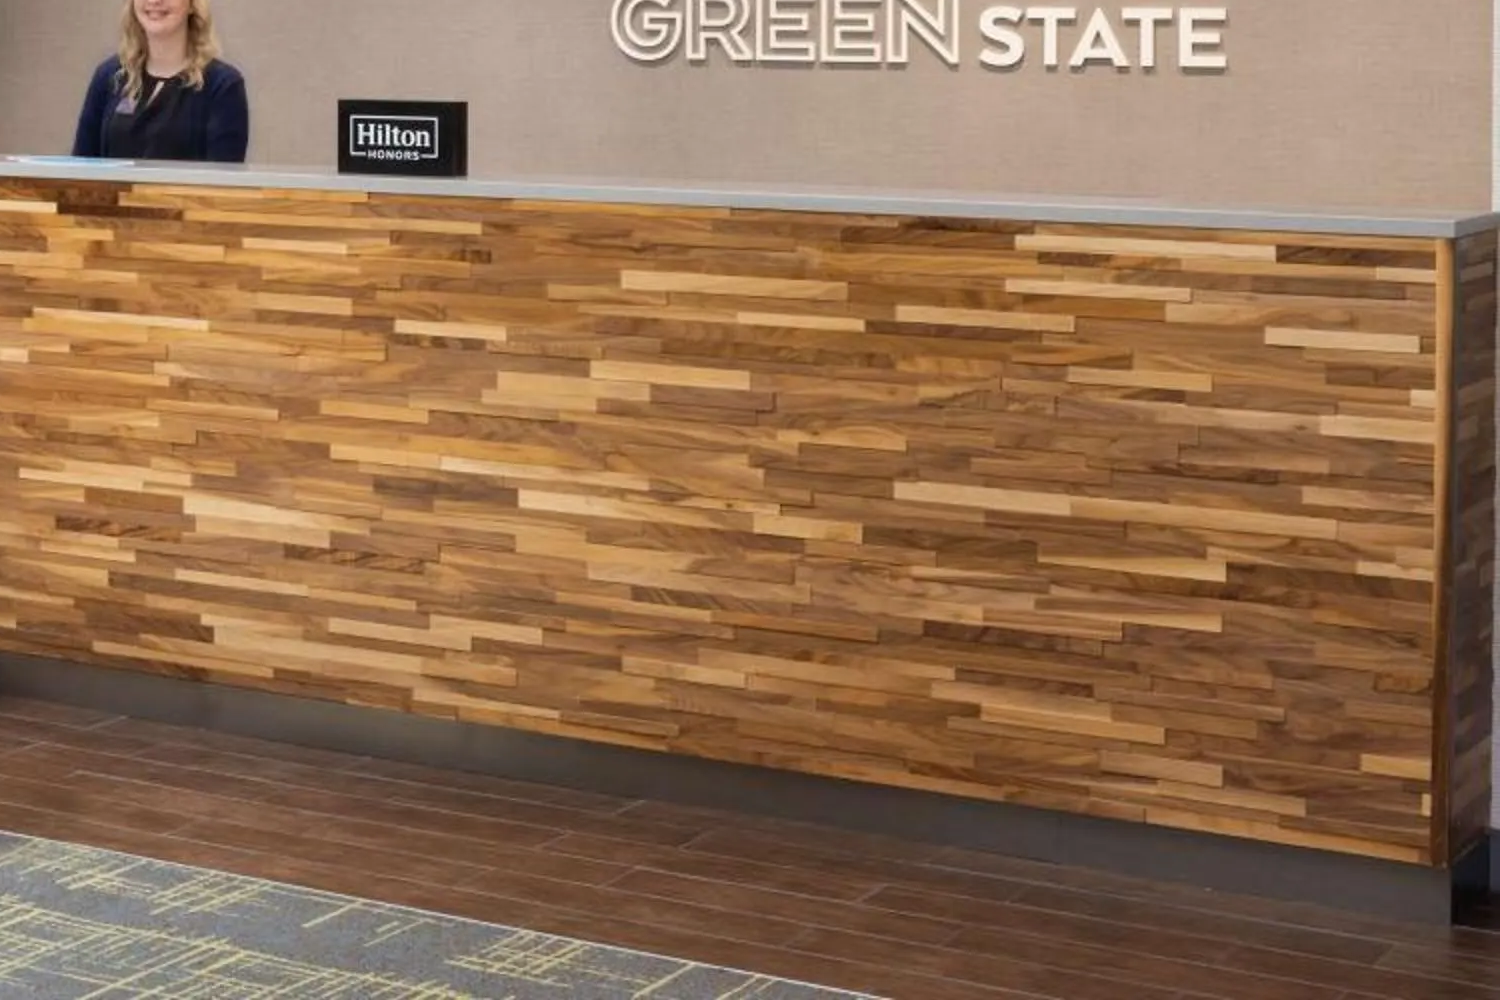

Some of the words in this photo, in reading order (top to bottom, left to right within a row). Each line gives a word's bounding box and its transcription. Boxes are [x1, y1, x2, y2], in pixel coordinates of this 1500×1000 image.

[977, 6, 1229, 70] STATE
[357, 123, 431, 147] Hilton
[367, 149, 420, 160] HONORS
